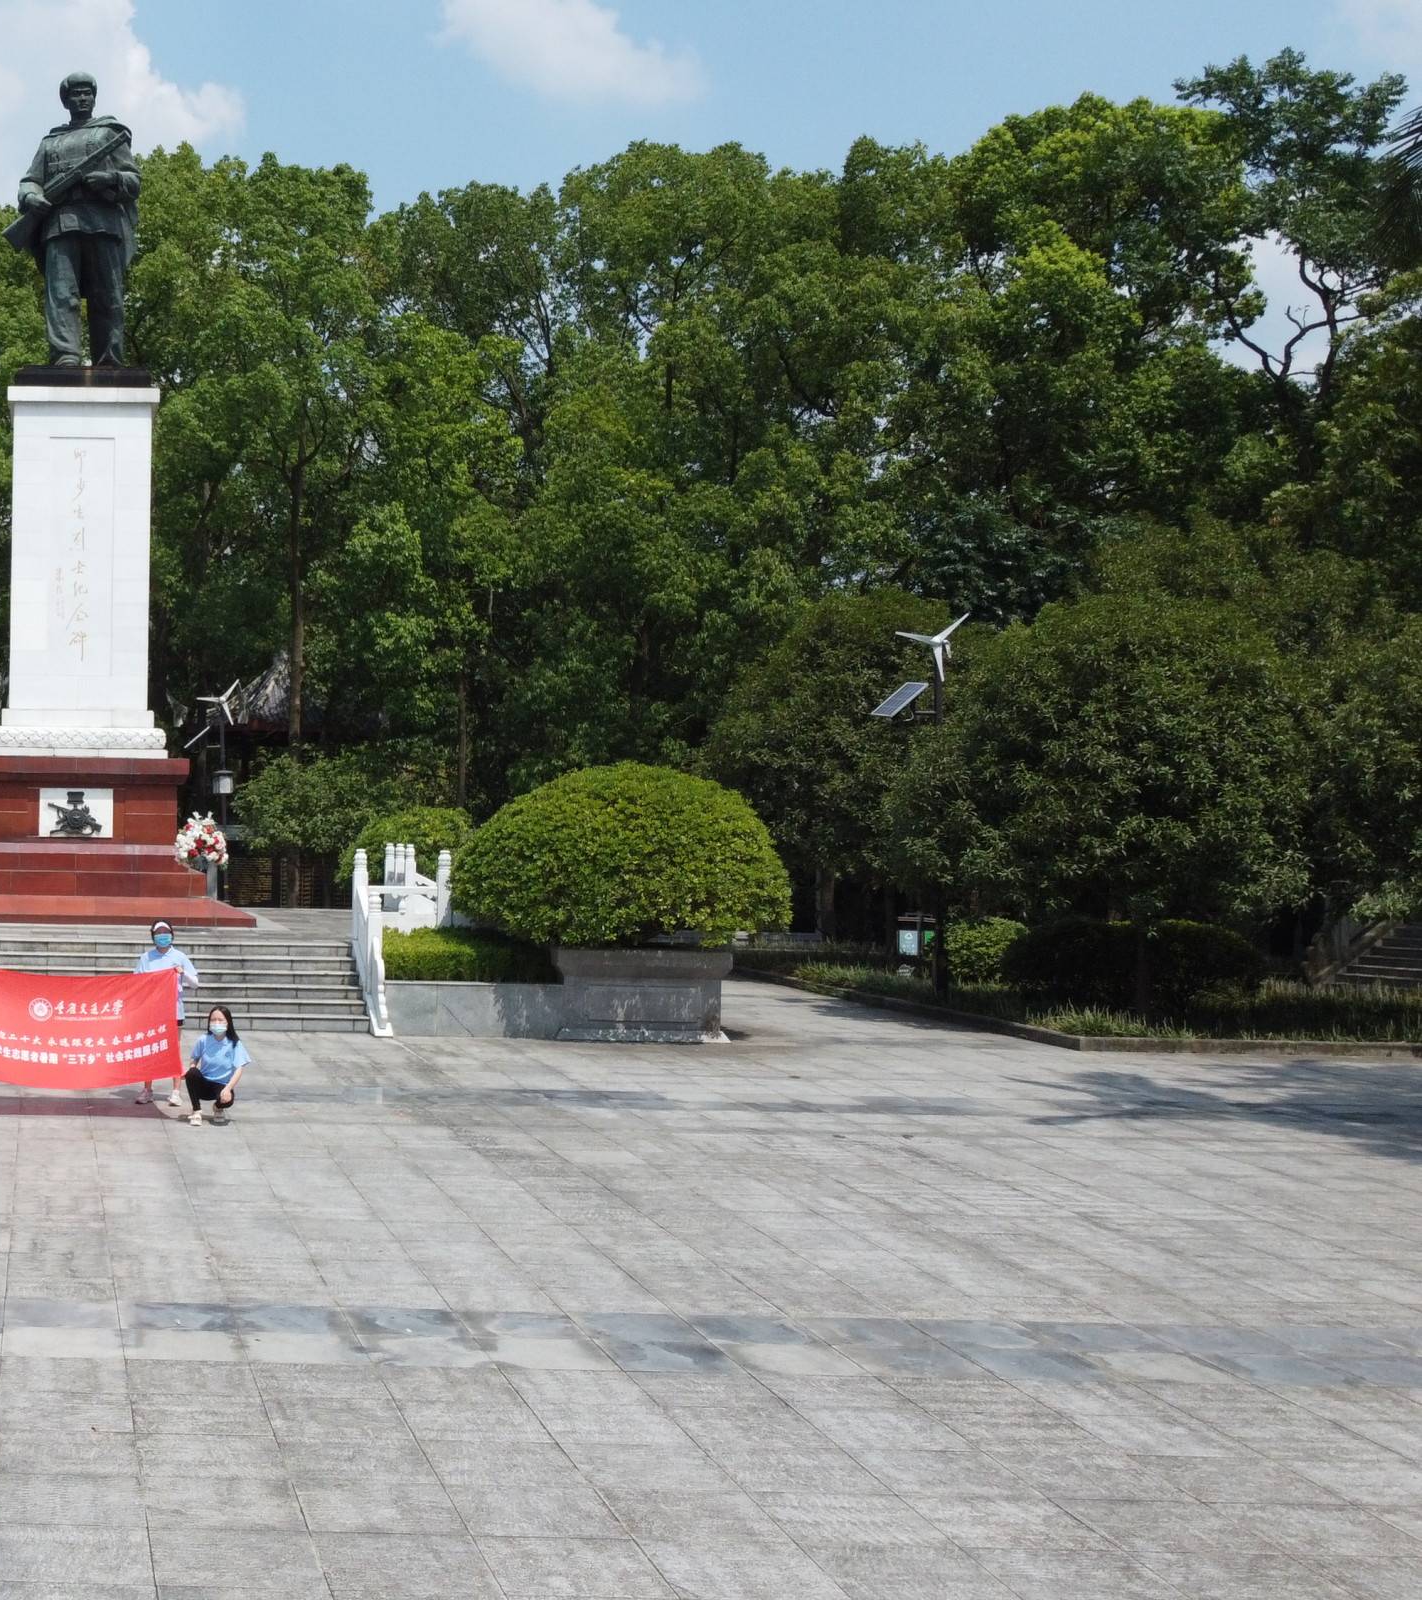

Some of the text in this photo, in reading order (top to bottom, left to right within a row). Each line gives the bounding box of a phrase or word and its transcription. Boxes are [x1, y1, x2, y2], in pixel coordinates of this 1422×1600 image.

[47, 1036, 107, 1048] 永远跟党走
